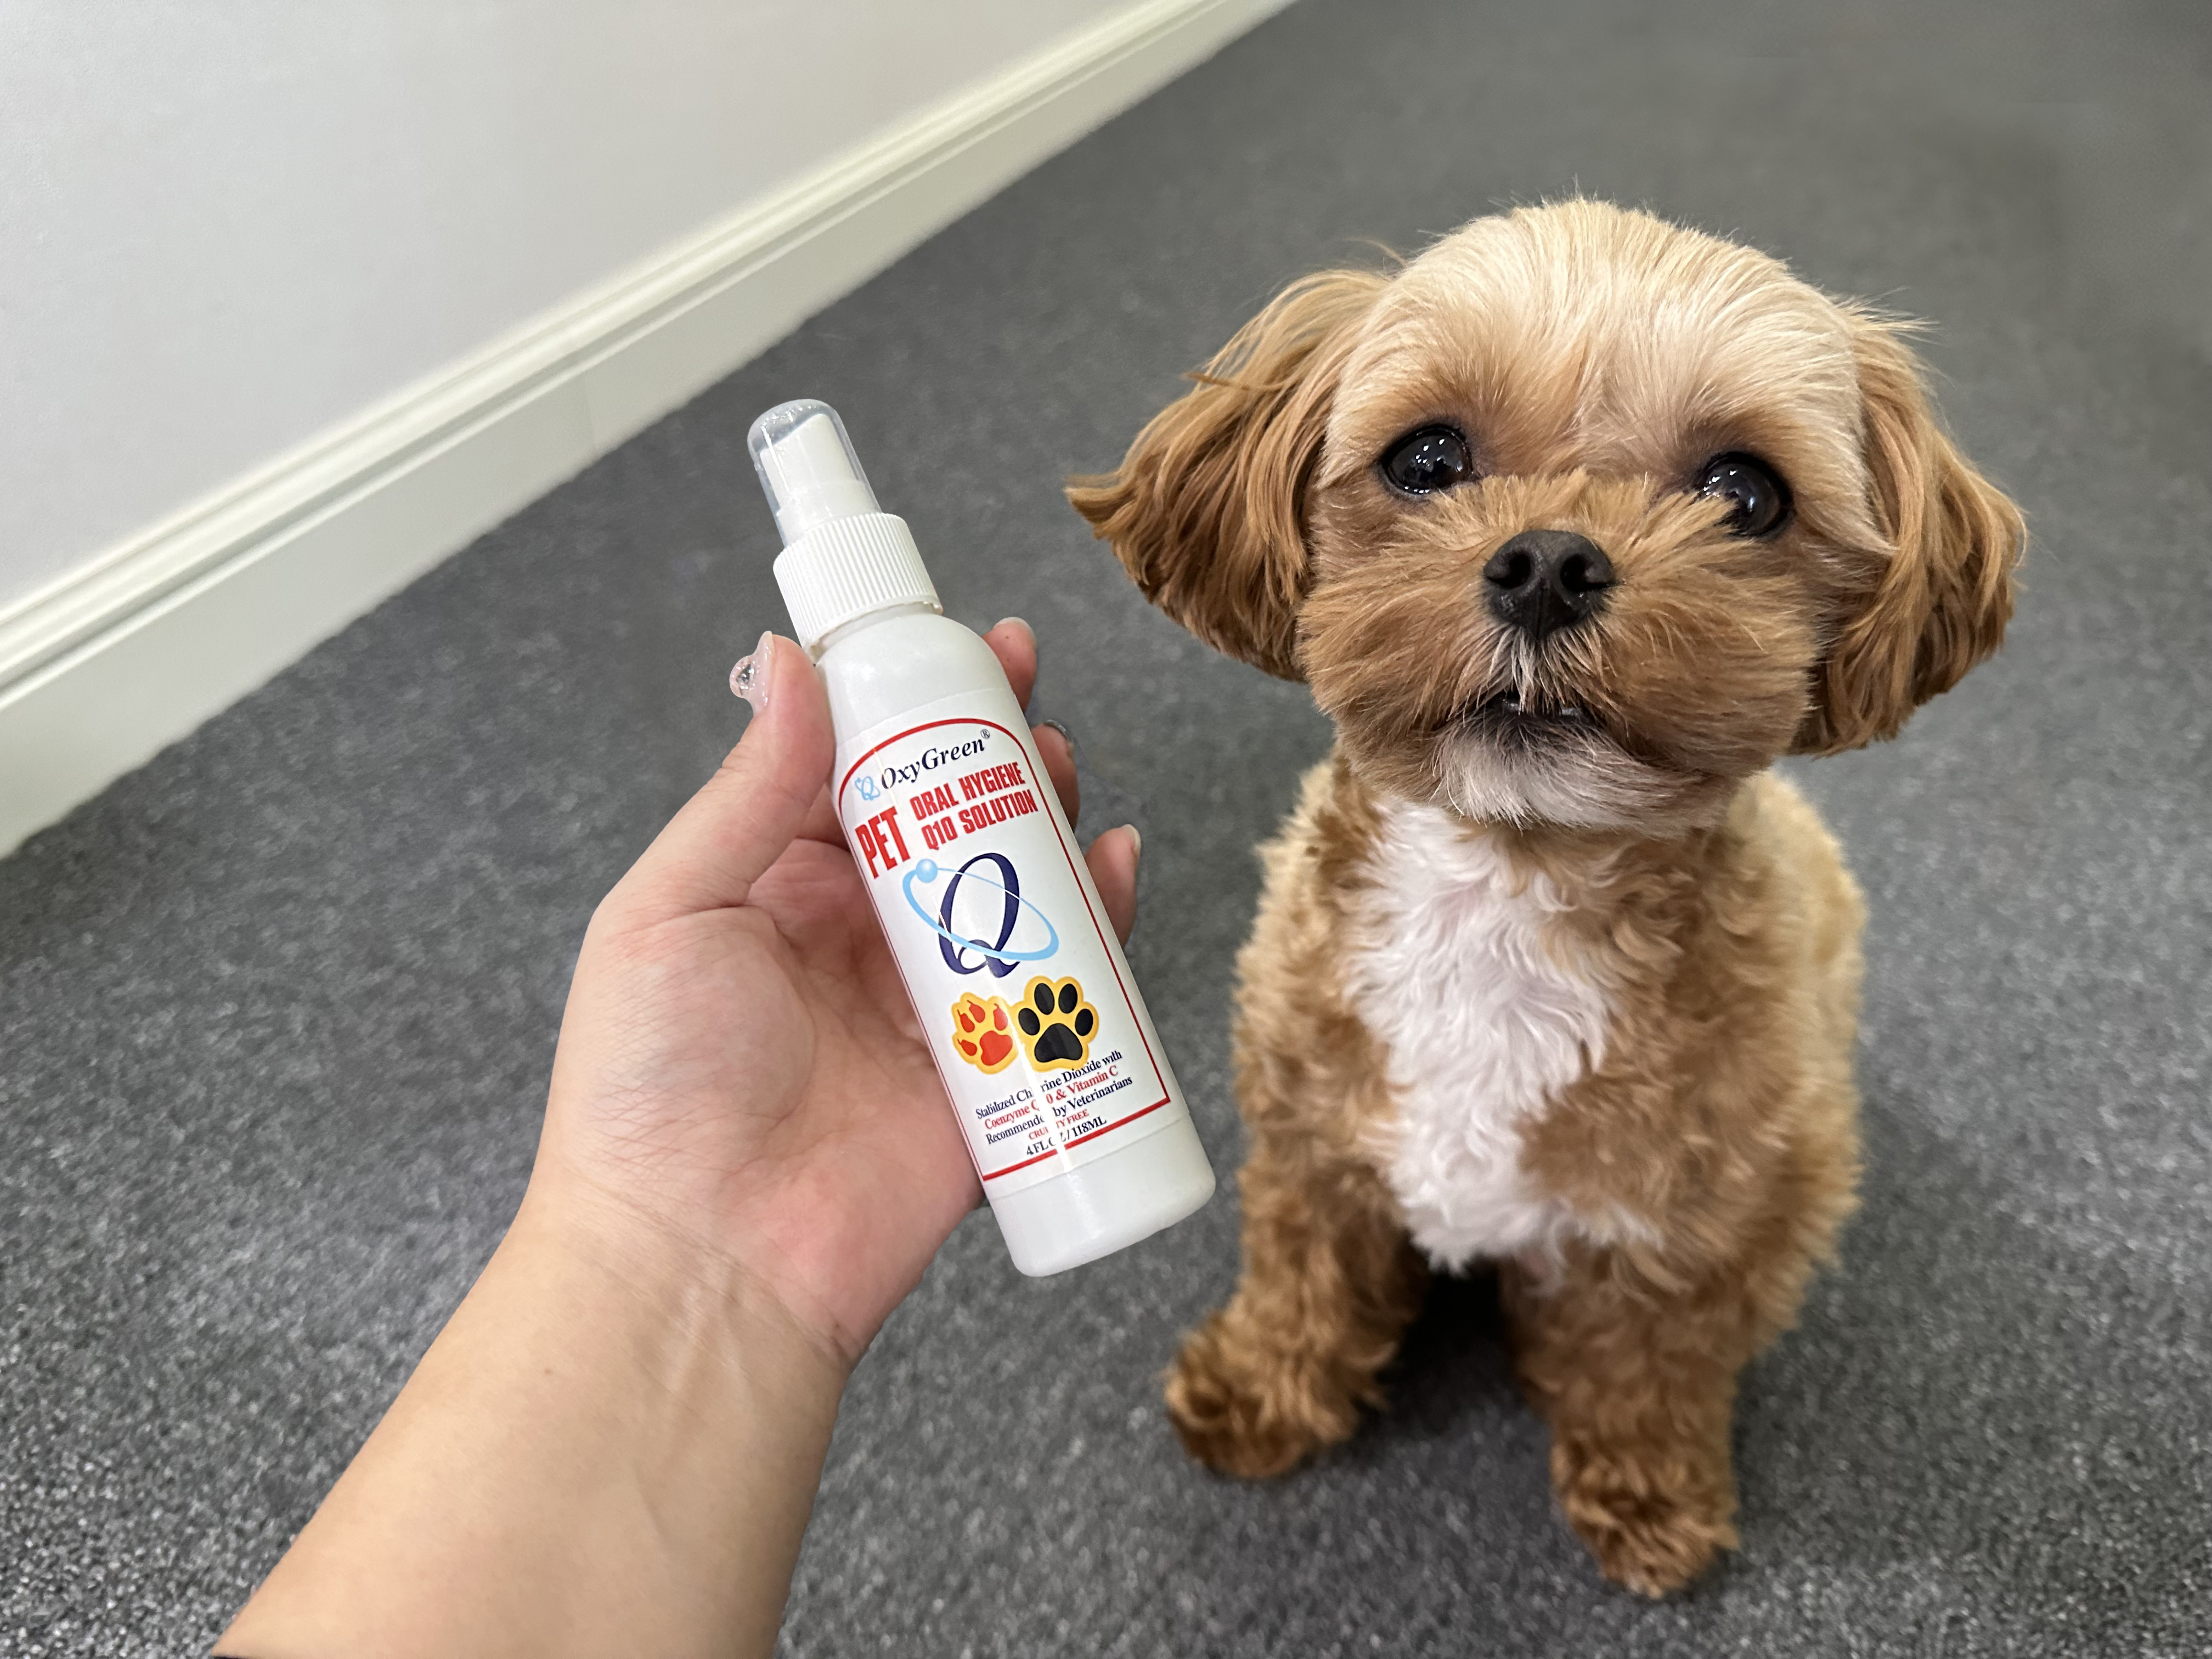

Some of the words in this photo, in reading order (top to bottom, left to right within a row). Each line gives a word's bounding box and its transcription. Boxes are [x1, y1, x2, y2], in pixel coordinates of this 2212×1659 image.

[910, 783, 960, 821] ORAL
[958, 762, 1025, 801] HYGIENE
[921, 816, 958, 850] Q10
[958, 789, 1039, 834] SOLUTION
[855, 805, 911, 879] PET
[975, 1095, 1016, 1119] Stabilized
[1016, 1078, 1062, 1102] Chrine
[1061, 1060, 1102, 1083] Dioxide
[1102, 1050, 1122, 1065] with
[985, 1105, 1030, 1130] Coenzyme
[1031, 1093, 1053, 1111] Q0
[1056, 1089, 1067, 1101] &
[1066, 1072, 1109, 1094] Vitamin
[1109, 1065, 1119, 1076] C
[986, 1115, 1045, 1144] Recommende
[1052, 1105, 1066, 1117] by
[1067, 1076, 1133, 1109] Veterinarians
[1032, 1140, 1048, 1153] FL
[1071, 1115, 1107, 1137] 118ML
[1066, 1109, 1090, 1124] FREE
